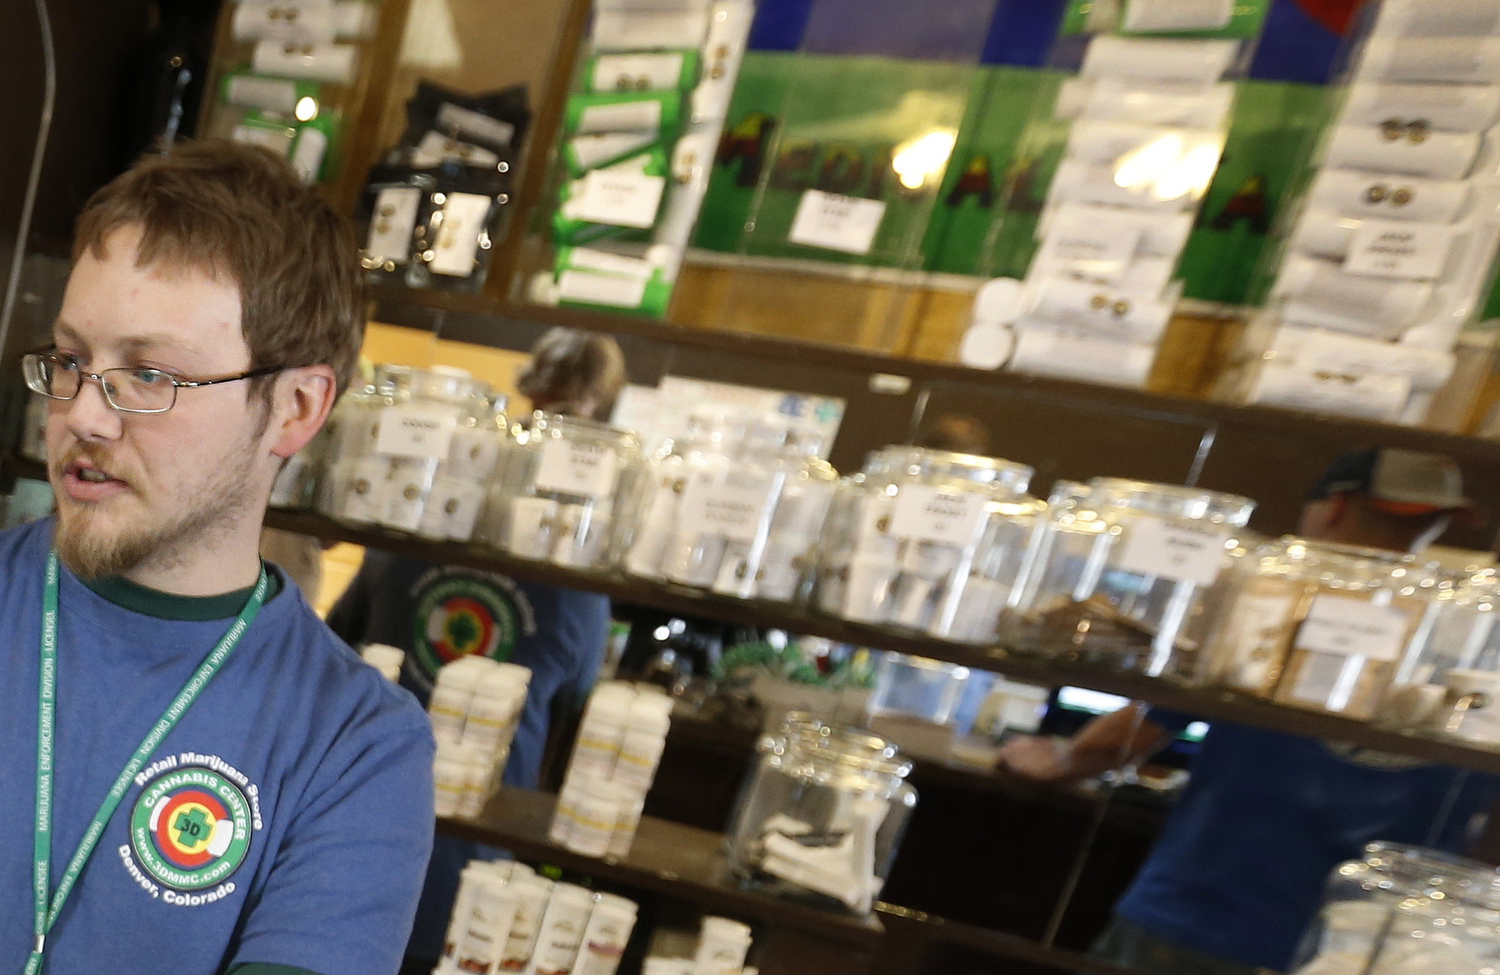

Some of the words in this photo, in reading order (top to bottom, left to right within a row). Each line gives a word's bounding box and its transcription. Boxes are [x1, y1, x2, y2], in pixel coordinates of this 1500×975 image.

[44, 609, 56, 650] LICENSEE
[208, 618, 249, 665] MARIJUANA
[42, 657, 54, 698] DIVISION
[165, 662, 215, 720] ENFORCEMENT
[40, 701, 53, 769] ENFORCEMENT
[137, 718, 171, 756] DIVISION
[38, 774, 51, 831] MARIJUANA
[106, 756, 144, 798] LICENSEE
[135, 755, 177, 787] Retail
[181, 752, 249, 785] Marijuana
[248, 783, 264, 831] Store
[145, 772, 218, 808] CANNABIS
[220, 786, 246, 840] CENTER
[181, 819, 200, 836] 3D
[68, 819, 102, 874] MARIJUANA
[136, 827, 231, 884] www.3DMMC.com
[35, 860, 48, 904] LICENSEE
[118, 843, 160, 898] Denver,
[163, 882, 236, 906] Colorado
